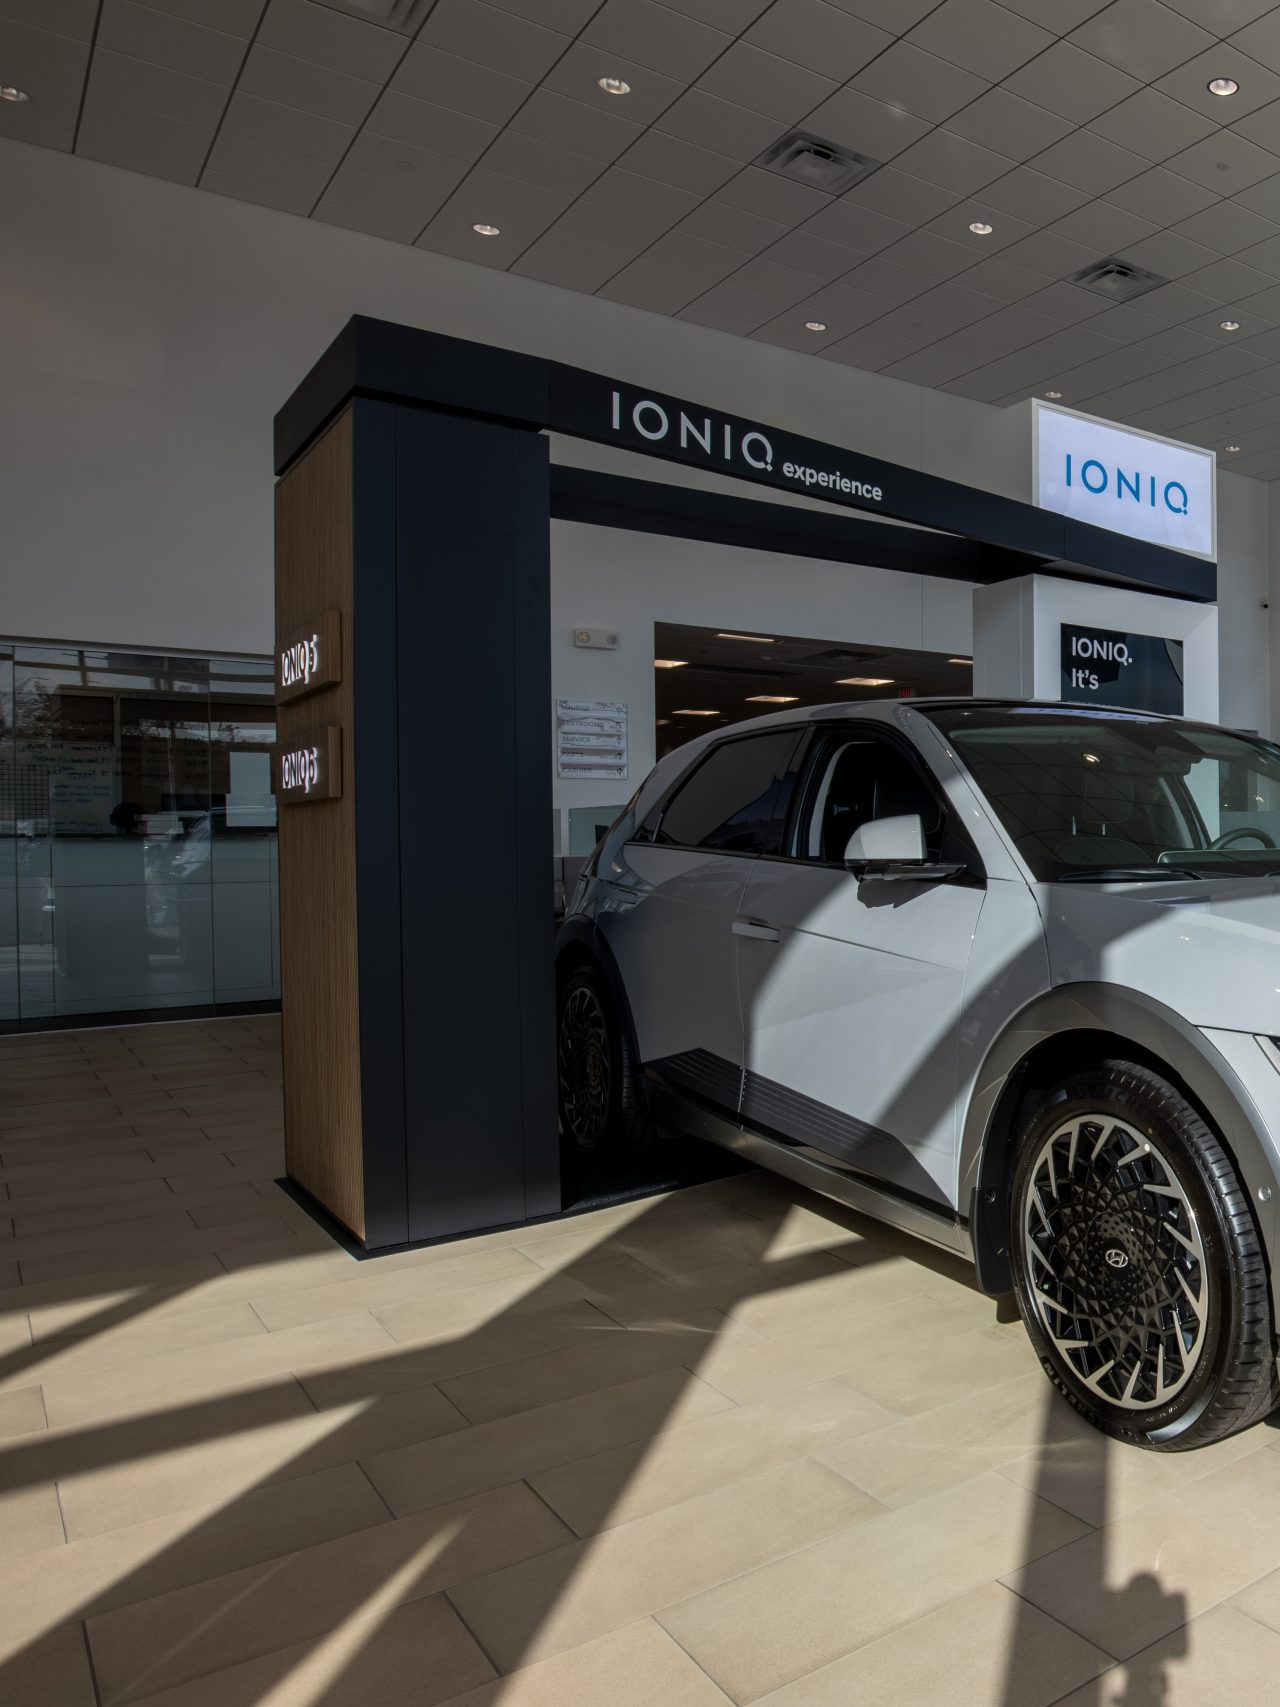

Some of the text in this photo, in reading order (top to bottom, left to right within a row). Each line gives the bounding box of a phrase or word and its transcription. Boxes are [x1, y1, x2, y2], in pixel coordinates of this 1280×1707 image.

[612, 391, 883, 501] IONIQ experience
[1066, 454, 1188, 516] IONIQ
[1072, 637, 1133, 666] IONIQ.
[561, 735, 591, 743] SERVICE
